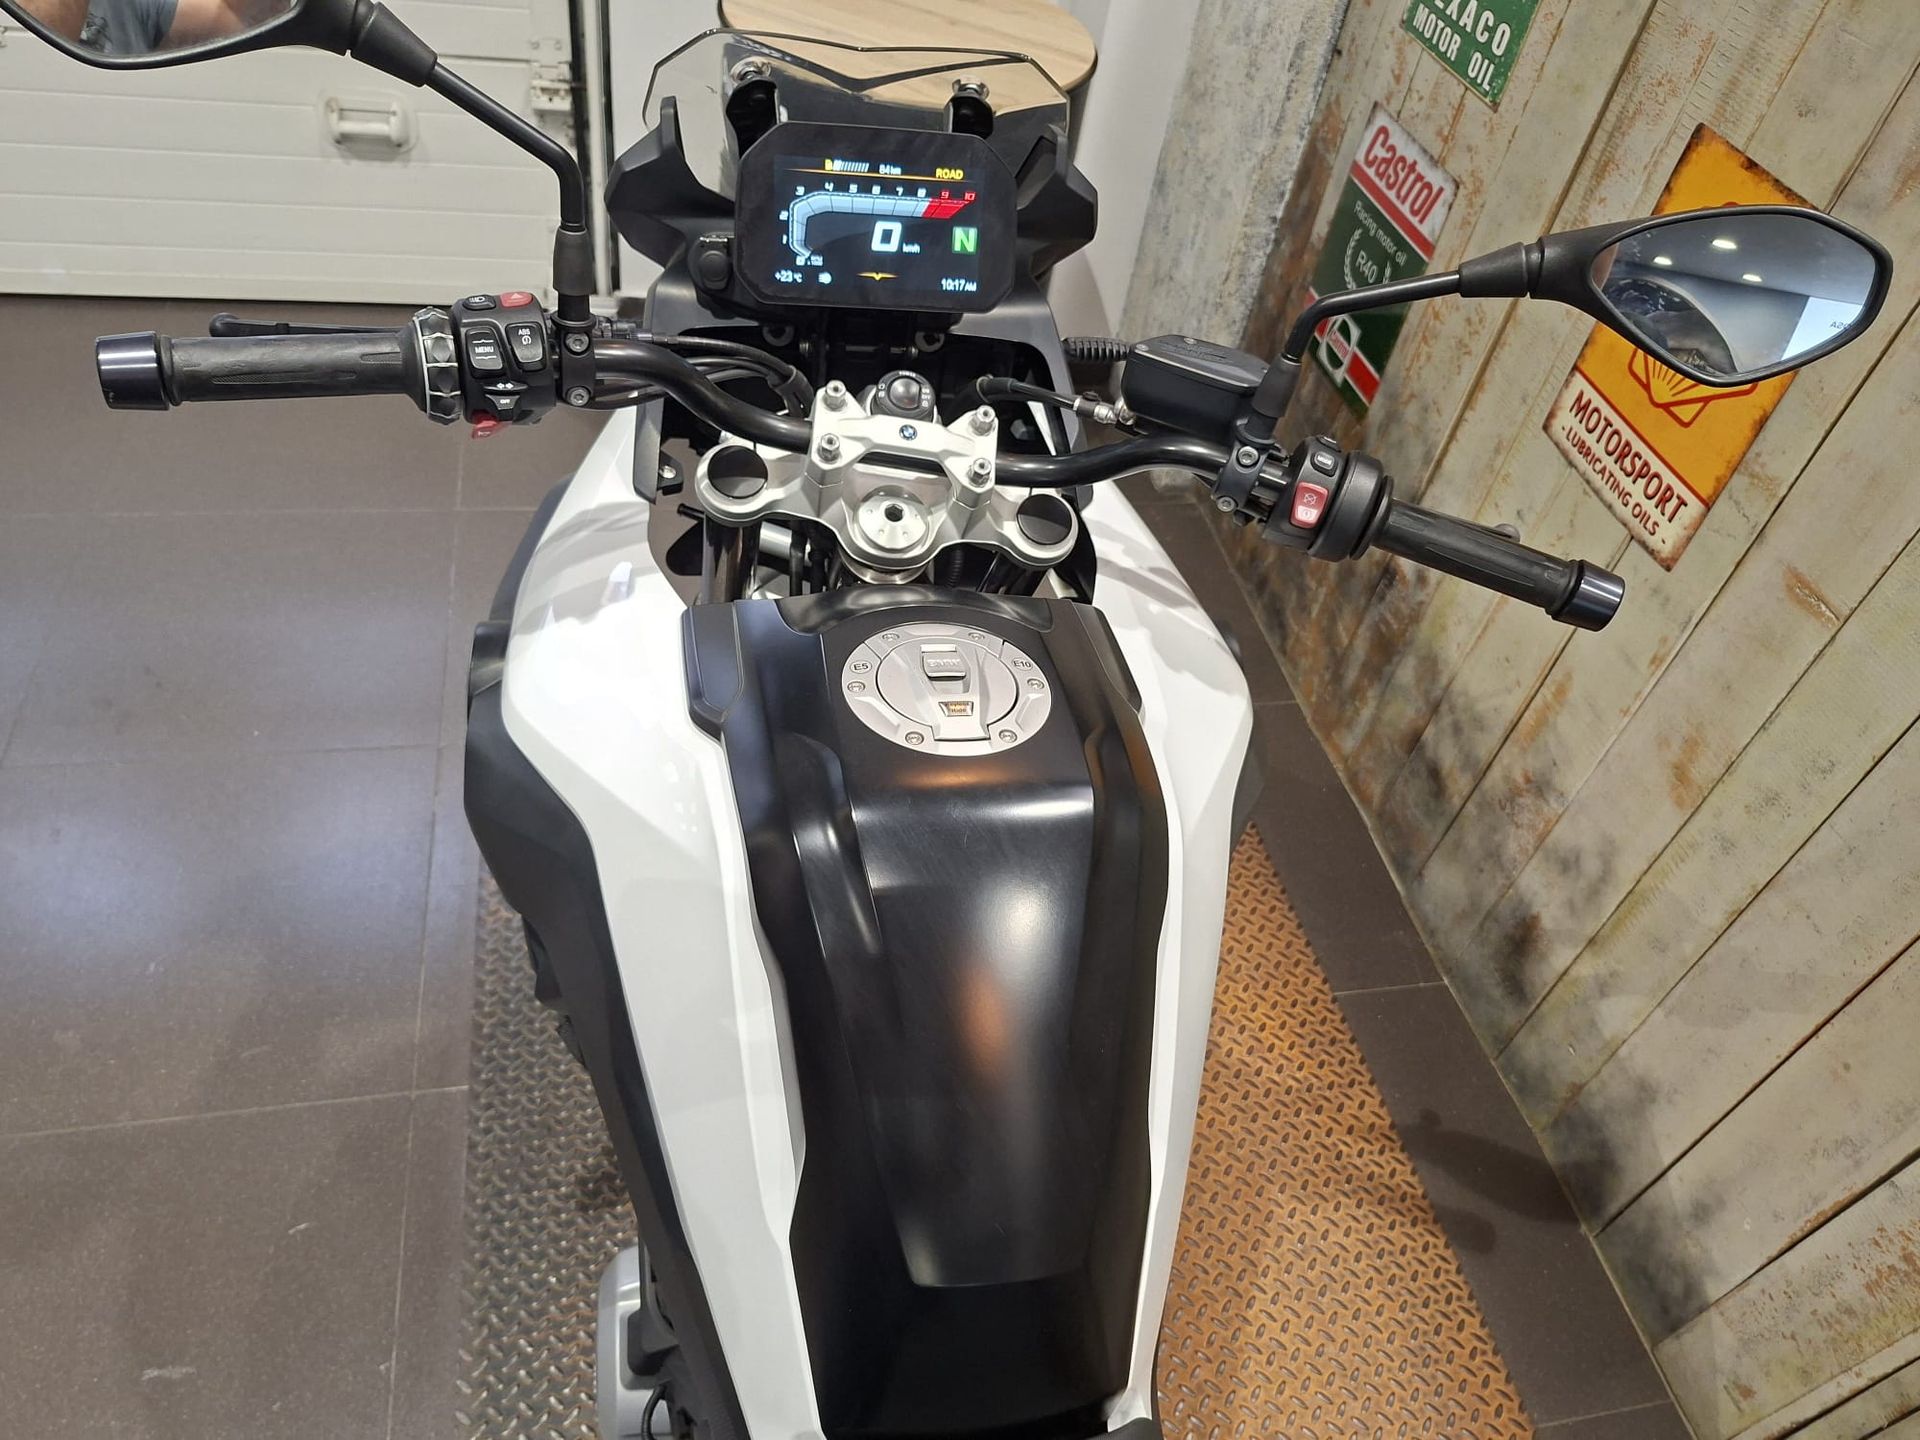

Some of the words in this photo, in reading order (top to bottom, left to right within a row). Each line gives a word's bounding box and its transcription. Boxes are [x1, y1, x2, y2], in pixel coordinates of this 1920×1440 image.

[1434, 0, 1511, 56] XACO
[1413, 3, 1461, 62] MOTOR
[1467, 51, 1495, 91] OIL
[936, 168, 964, 180] ROAD
[1364, 125, 1445, 224] Castrol
[795, 186, 805, 196] 3
[824, 182, 834, 191] 4
[849, 184, 858, 193] 5
[896, 187, 904, 196] 7
[940, 190, 950, 199] 9
[964, 191, 976, 201] 10
[871, 220, 902, 253] 0
[953, 227, 976, 252] N
[1353, 200, 1378, 237] Racing
[1375, 229, 1398, 255] motor
[1395, 251, 1408, 266] oil
[1355, 249, 1378, 284] R40
[518, 328, 531, 336] ABS
[475, 346, 494, 354] MENU
[1569, 389, 1688, 523] MOTORSPORT
[1565, 426, 1633, 508] LUBRICATING
[1631, 502, 1660, 537] OILS
[854, 663, 869, 671] E5
[1013, 660, 1033, 669] E10
